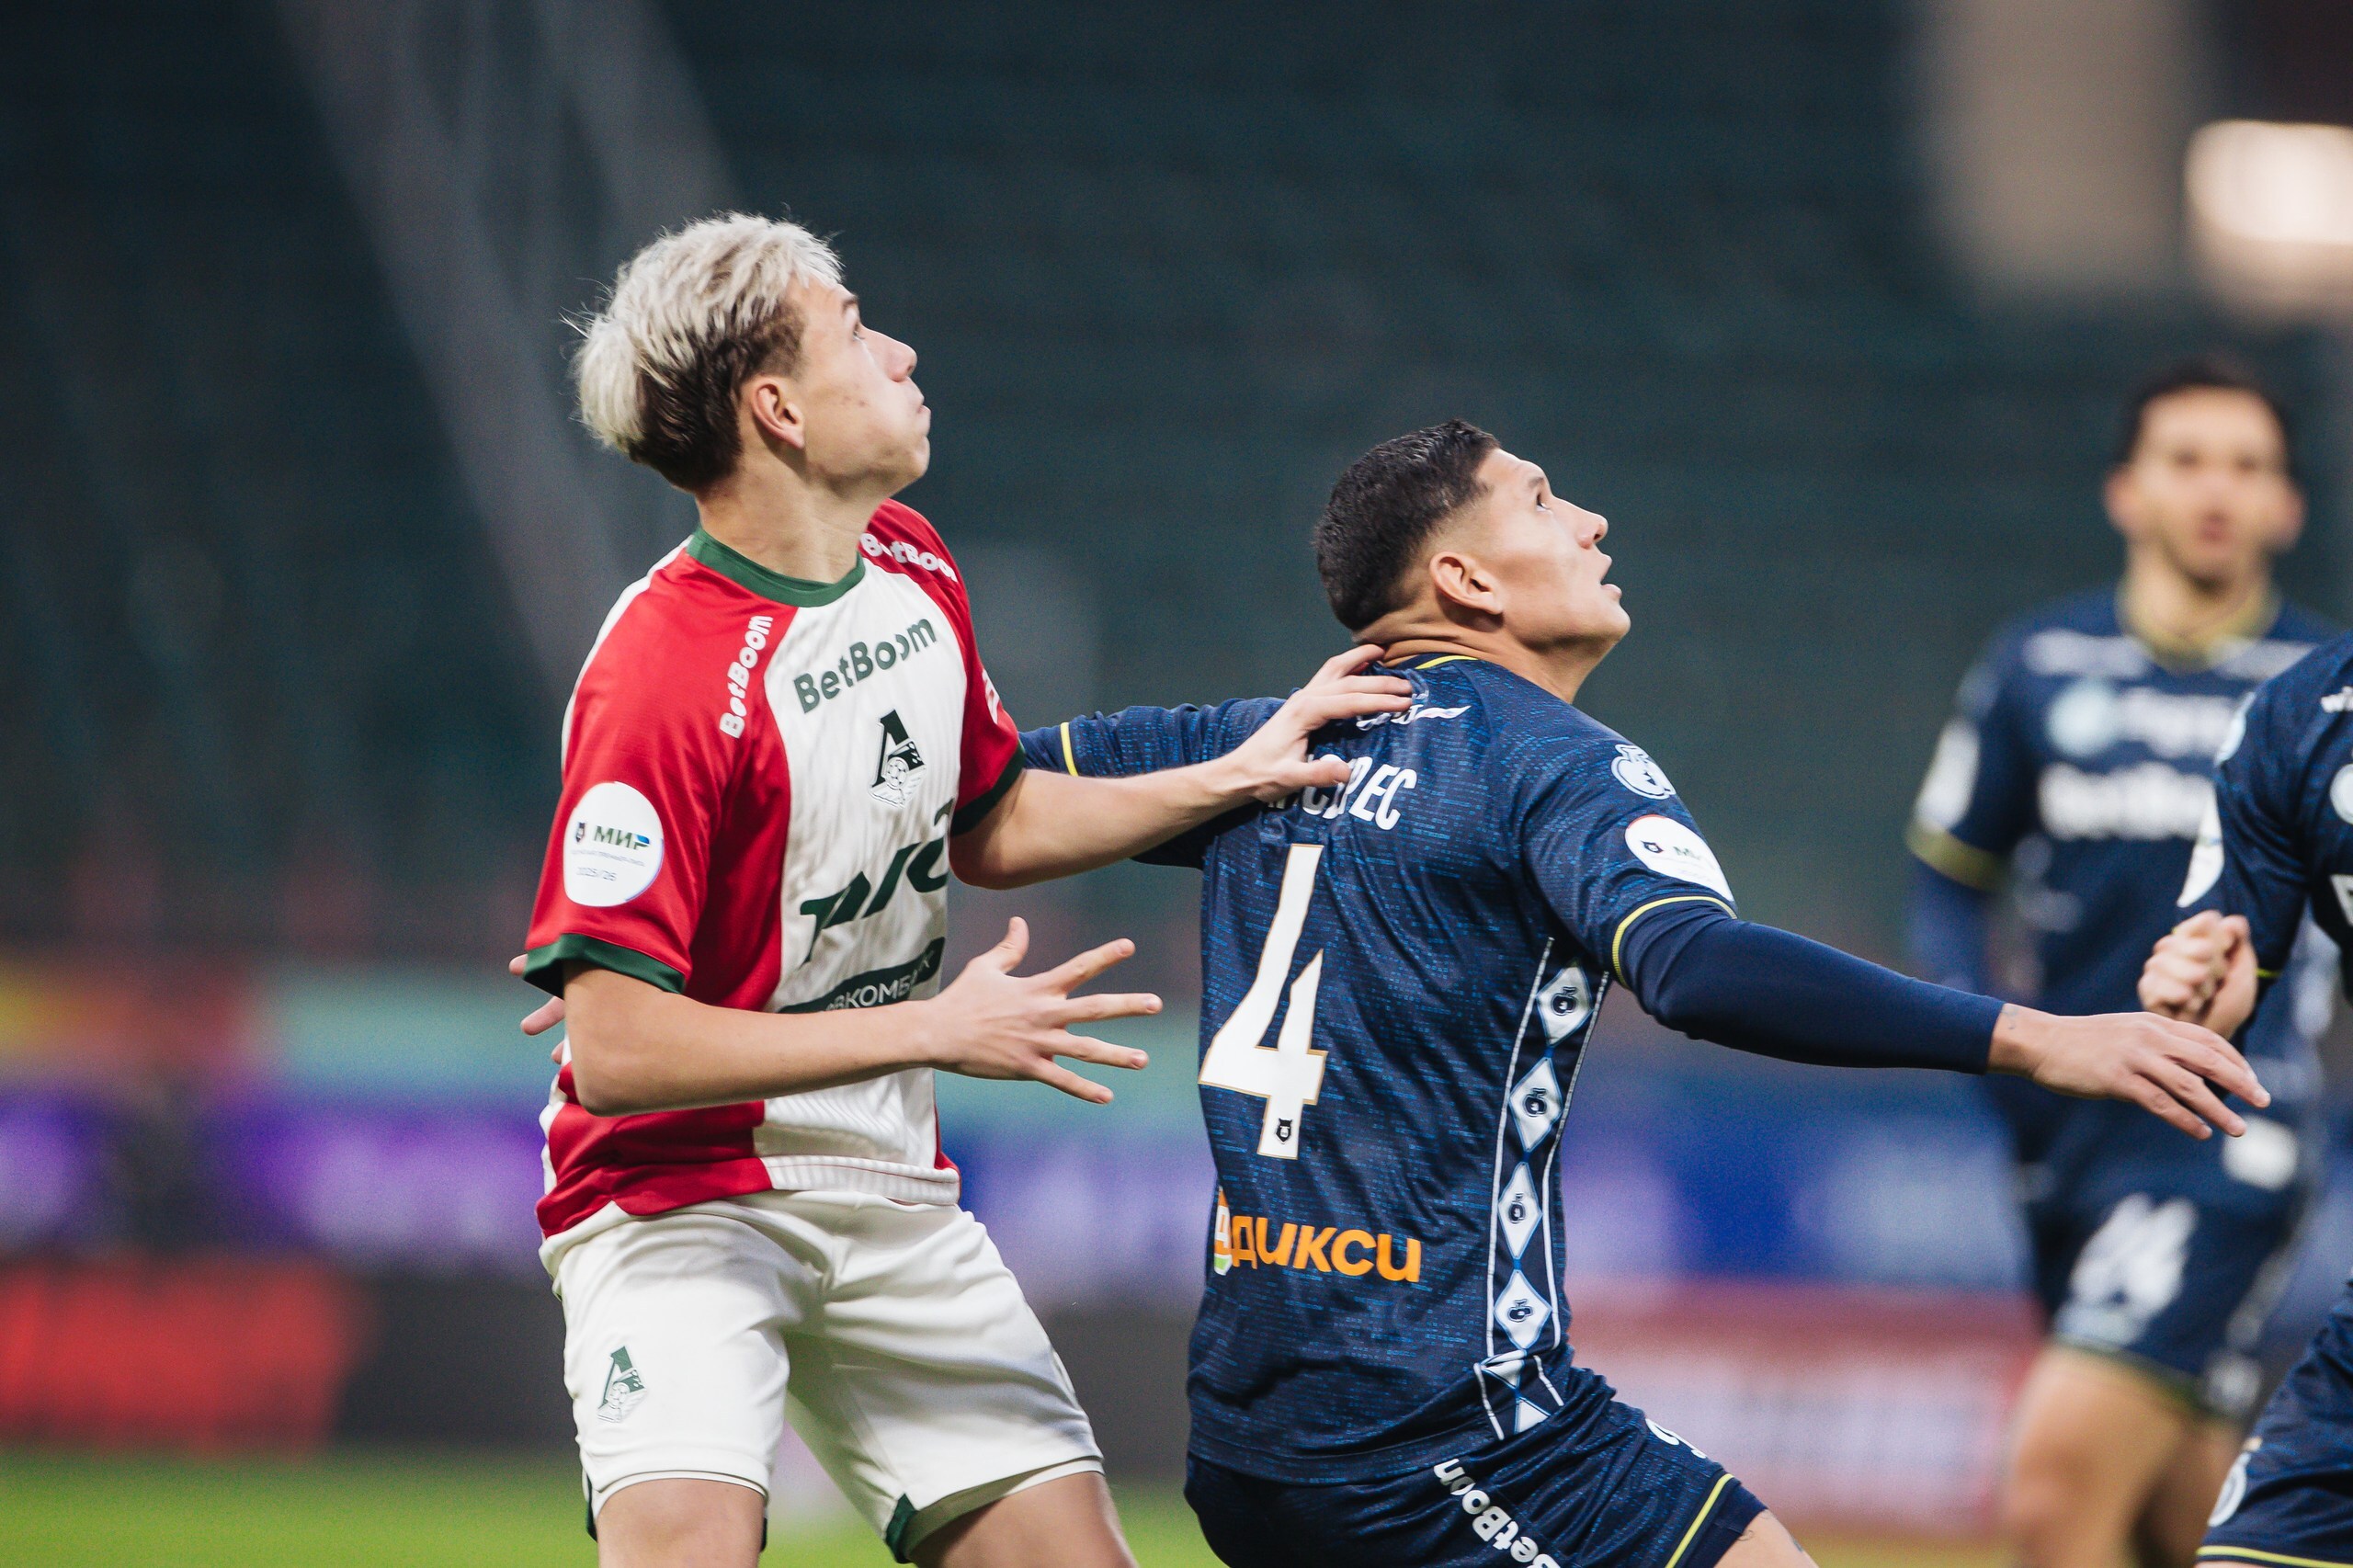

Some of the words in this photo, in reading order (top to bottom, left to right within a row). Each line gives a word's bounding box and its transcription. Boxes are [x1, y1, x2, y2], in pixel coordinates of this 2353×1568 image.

[719, 615, 774, 739] BetBoom
[593, 825, 651, 850] МИР
[1198, 843, 1329, 1161] 4
